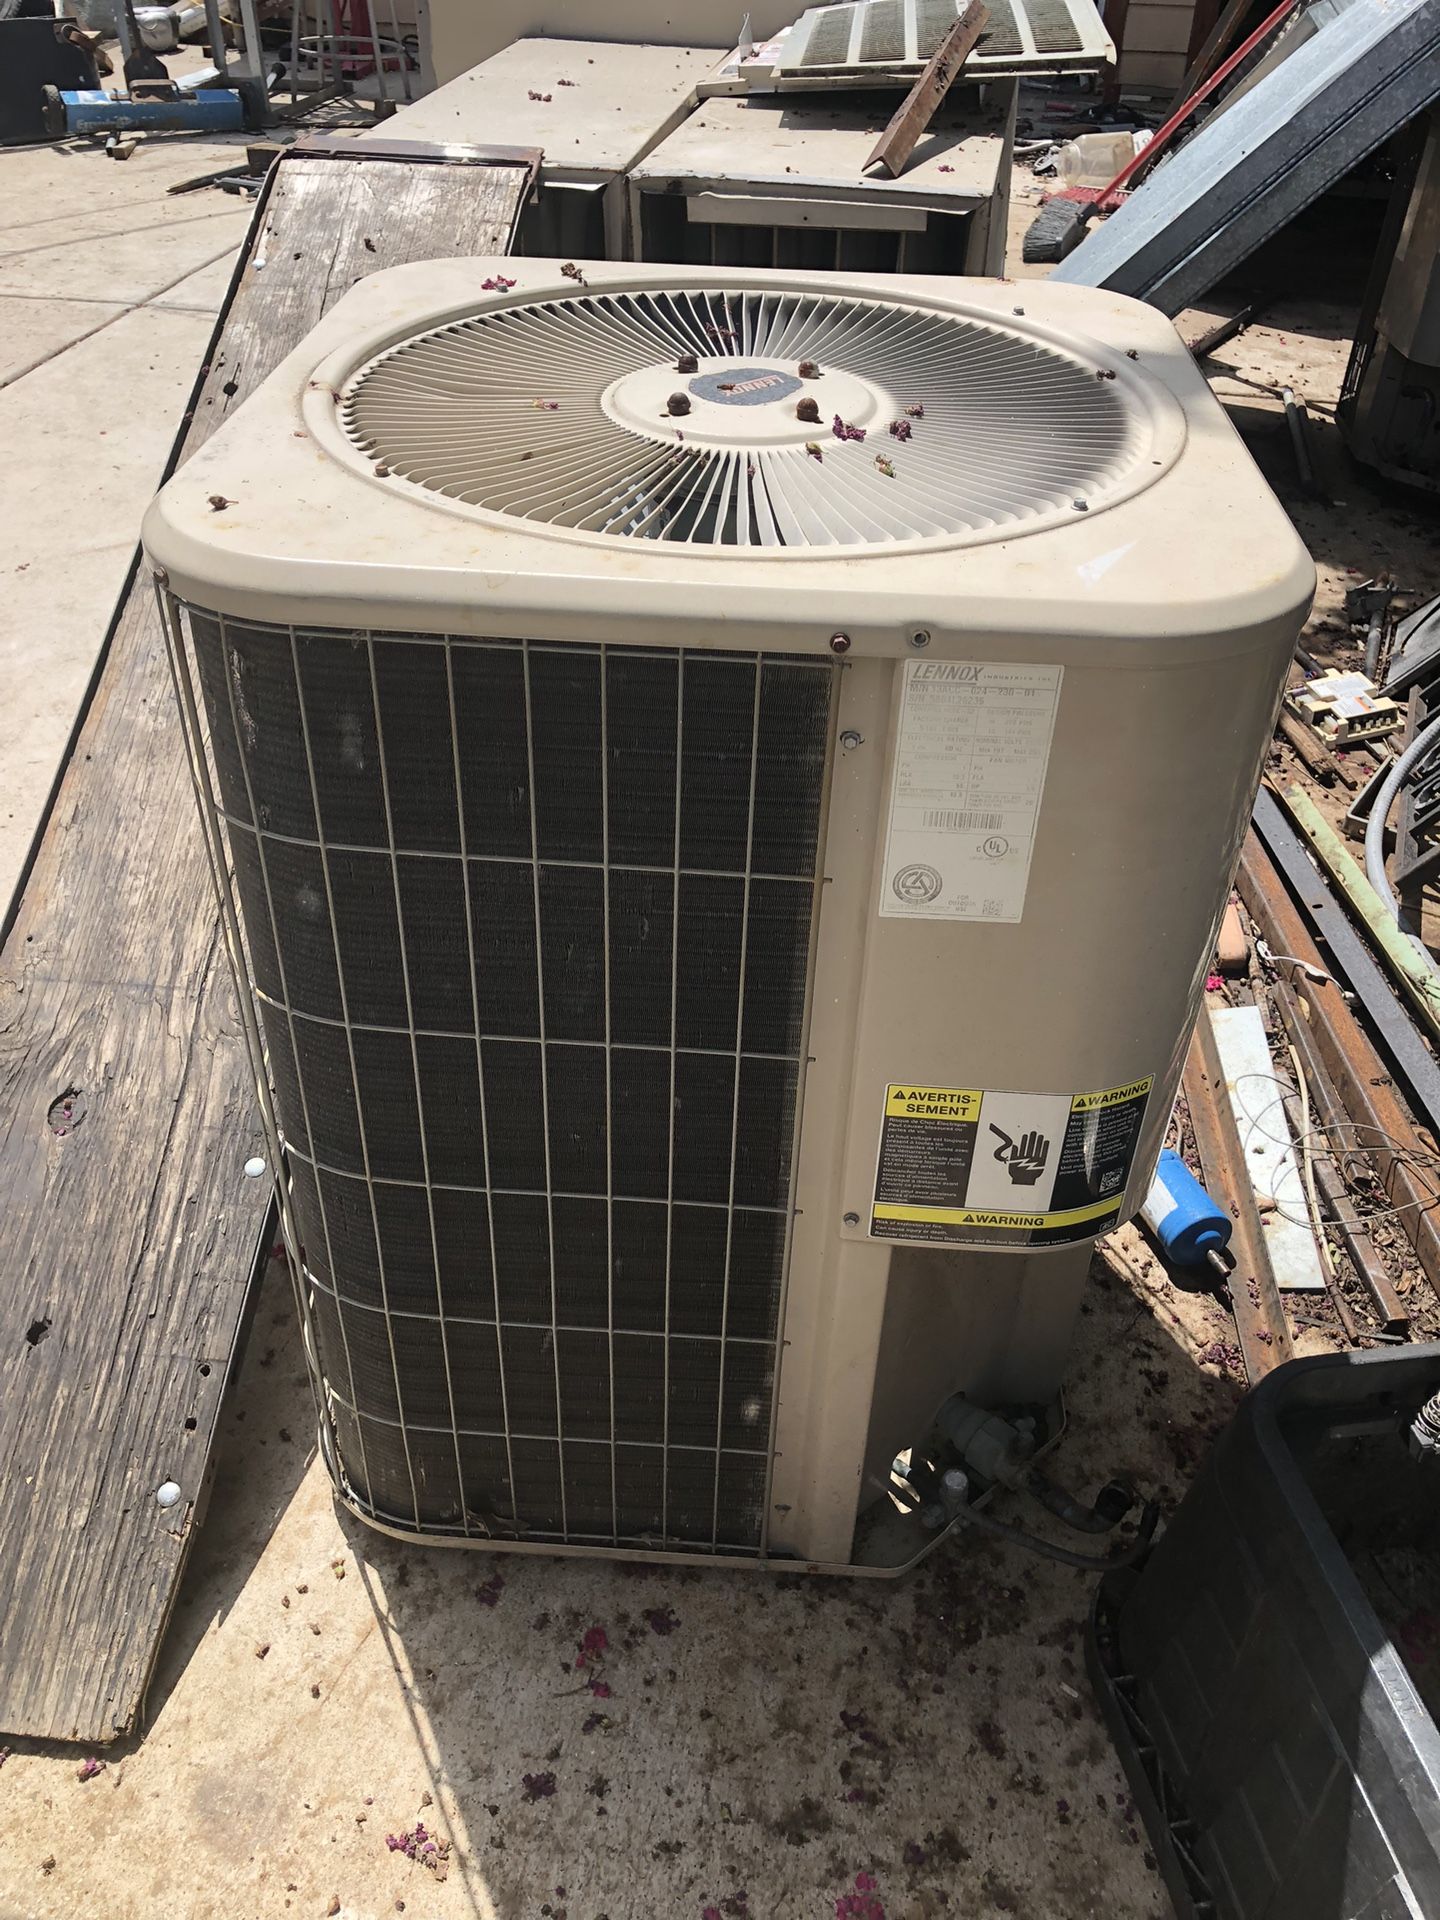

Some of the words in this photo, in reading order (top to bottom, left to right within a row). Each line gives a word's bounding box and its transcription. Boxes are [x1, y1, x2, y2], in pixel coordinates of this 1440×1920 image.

[721, 375, 784, 397] LENNOX
[913, 664, 984, 681] LENNOX
[908, 1091, 977, 1104] AVERTIS-
[1088, 1081, 1148, 1106] WARNING
[906, 1104, 969, 1116] SEMENT
[976, 1215, 1044, 1226] WARNING
